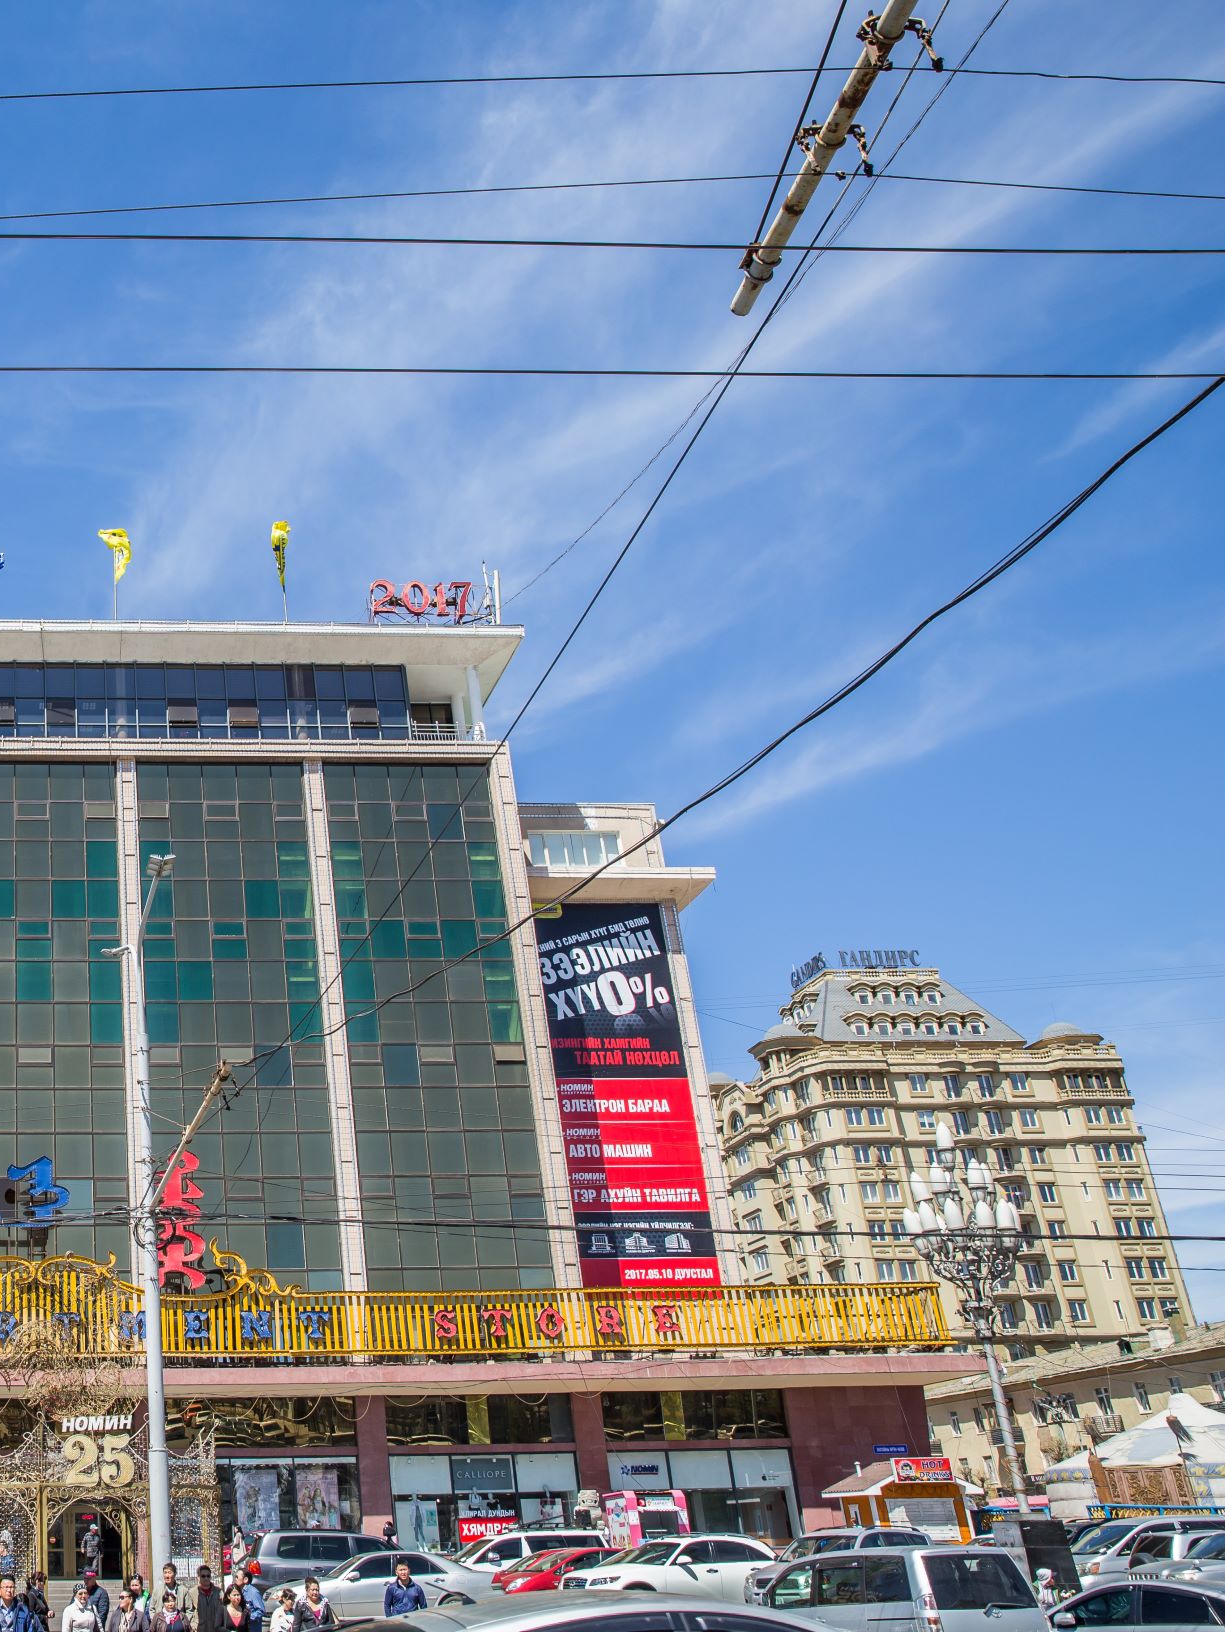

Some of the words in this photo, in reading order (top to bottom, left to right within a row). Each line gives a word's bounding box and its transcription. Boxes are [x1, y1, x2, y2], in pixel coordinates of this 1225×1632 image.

[370, 579, 472, 621] 2017
[538, 939, 556, 953] НИЙ
[556, 939, 563, 948] 3
[563, 931, 590, 946] САРЫН
[590, 926, 608, 939] ХҮҮГ
[610, 922, 626, 935] БИД
[625, 915, 650, 930] ТӨЛНӨ
[540, 929, 661, 985] ЗЭЭЛИЙН
[838, 949, 922, 968] ГАНДИРС
[551, 1037, 601, 1049] ИЗИНГИЙН
[604, 1037, 651, 1049] ХАМГИЙН
[575, 1050, 624, 1065] ТААТАЙ
[625, 1050, 680, 1067] НӨХЦӨЛ
[560, 1083, 594, 1091] НОМИН
[562, 1099, 626, 1113] ЭЛЕКТРОН
[628, 1099, 671, 1113] БАРАА
[566, 1128, 601, 1136] НОМИН
[569, 1144, 601, 1158] АВТО
[603, 1144, 653, 1158] МАШИН
[572, 1172, 606, 1180] НОМИН
[573, 1188, 597, 1203] ГЭР
[600, 1187, 641, 1203] АХУЙН
[644, 1188, 701, 1203] ТАВИЛГА
[624, 1268, 673, 1279] 2017.05.10
[674, 1268, 714, 1280] ДУУСТАЛ
[434, 1304, 681, 1338] STORE
[62, 1414, 133, 1433] НОМИН
[63, 1433, 135, 1488] 25
[921, 1460, 944, 1470] HOT
[456, 1470, 507, 1479] CALLIOPE
[631, 1464, 659, 1475] NOMIN
[919, 1471, 950, 1479] DRINKS
[488, 1509, 515, 1518] ДУНДЫН
